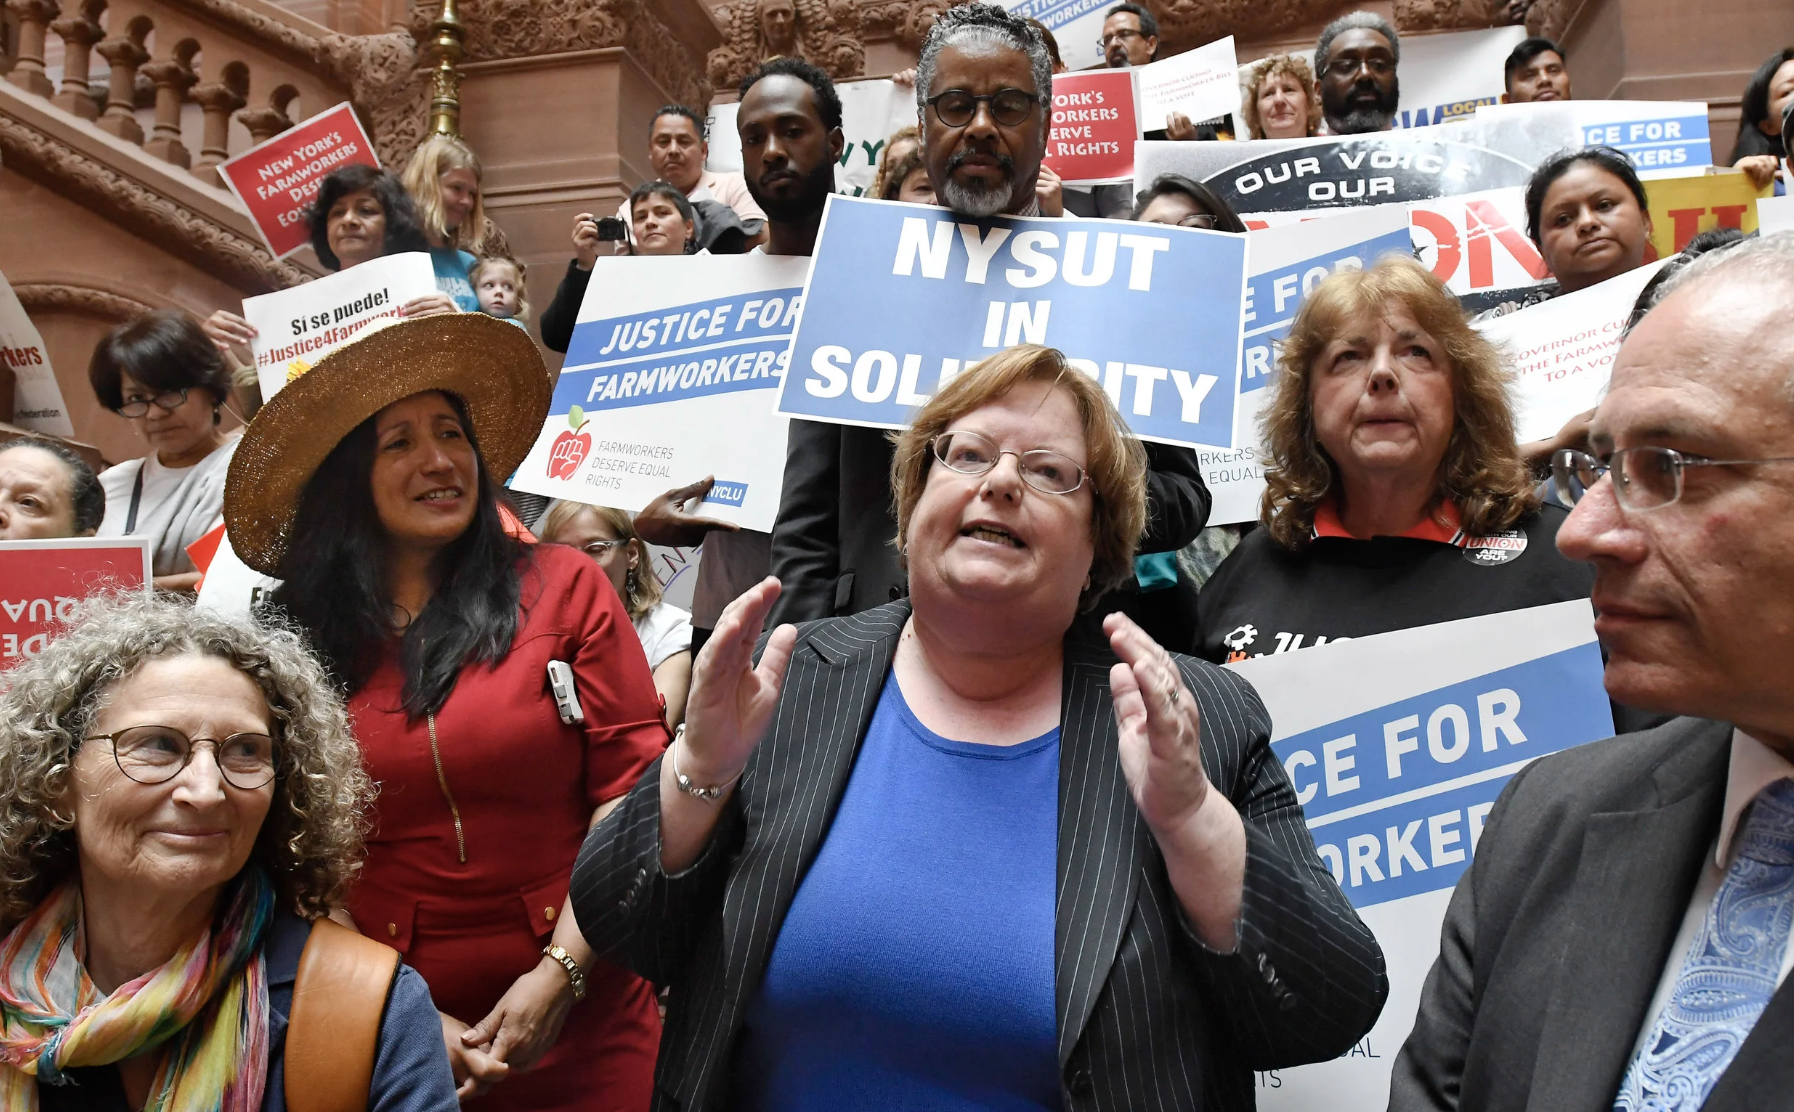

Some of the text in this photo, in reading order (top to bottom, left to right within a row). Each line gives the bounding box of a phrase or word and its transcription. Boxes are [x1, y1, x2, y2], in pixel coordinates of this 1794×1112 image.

[1052, 90, 1105, 107] ORK'S
[1629, 121, 1682, 142] FOR
[257, 131, 343, 181] NEW YORK'S
[1057, 141, 1120, 157] RIGHTS
[256, 142, 358, 201] FARMWORKERS
[1235, 156, 1321, 196] OUR
[1308, 176, 1396, 201] OUR
[892, 217, 1170, 292] NYSUT
[311, 311, 331, 329] se
[333, 287, 390, 324] puede!
[599, 304, 732, 355] JUSTICE
[982, 300, 1051, 348] IN
[1520, 358, 1550, 375] THE
[1543, 369, 1567, 382] TO
[1571, 365, 1583, 375] A
[598, 440, 675, 460] FARMWORKERS
[591, 457, 671, 478] DESERVE EQUAL
[1209, 466, 1264, 485] EQUAL
[585, 474, 622, 490] RIGHTS
[707, 485, 743, 501] NYCLU
[1468, 537, 1525, 550] UNION
[1475, 553, 1508, 561] YOU?
[1383, 688, 1528, 780] FOR
